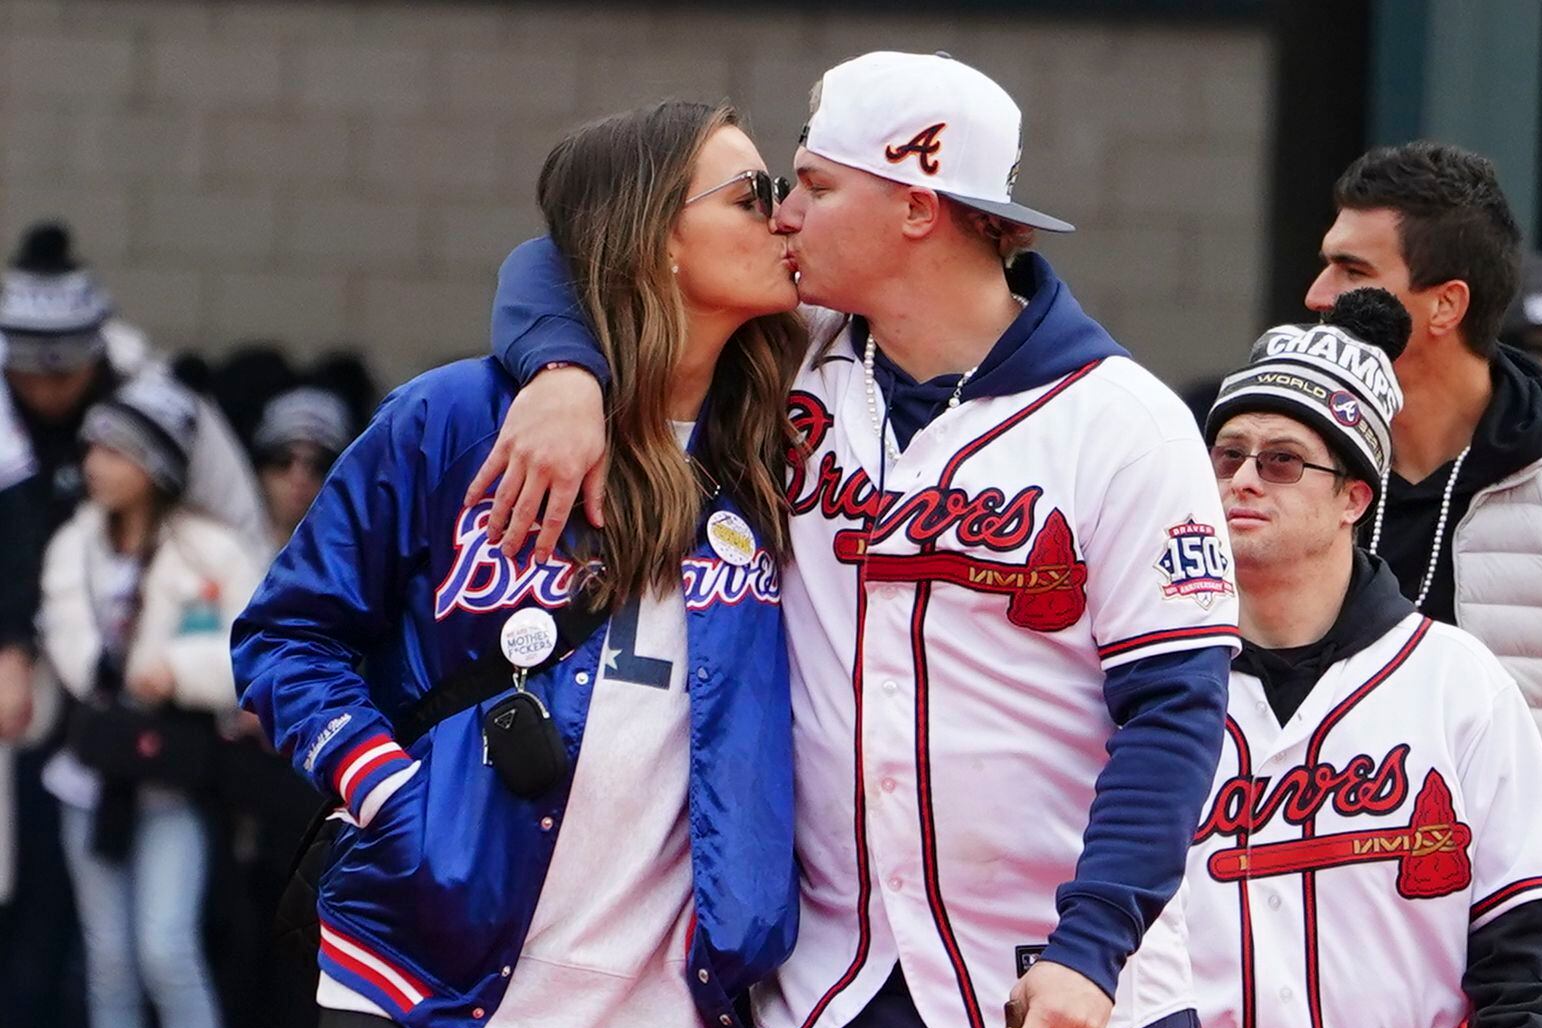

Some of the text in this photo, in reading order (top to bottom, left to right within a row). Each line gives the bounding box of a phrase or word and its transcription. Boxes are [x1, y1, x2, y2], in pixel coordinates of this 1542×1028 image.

[885, 122, 947, 175] A
[1256, 373, 1327, 399] WORLD
[1167, 536, 1224, 581] 150
